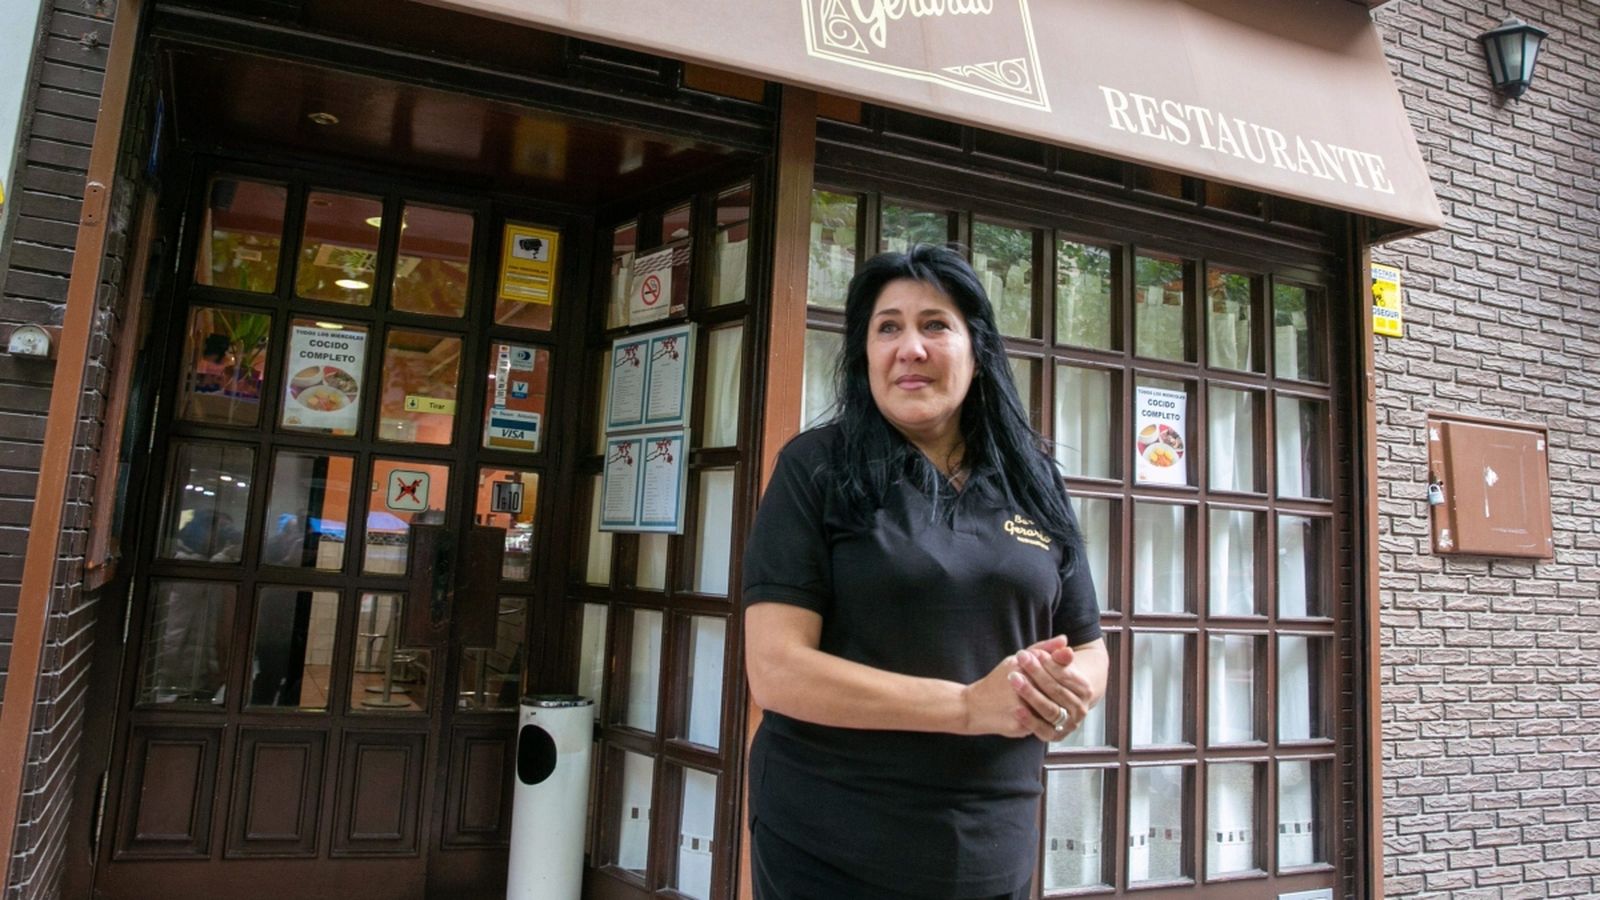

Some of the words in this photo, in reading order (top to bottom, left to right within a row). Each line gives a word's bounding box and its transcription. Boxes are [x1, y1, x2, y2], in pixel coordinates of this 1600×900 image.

[1099, 85, 1396, 195] RESTAURANTE
[309, 339, 349, 350] COCIDO
[299, 351, 355, 363] COMPLETO
[1147, 398, 1175, 409] COCIDO
[1141, 409, 1181, 421] COMPLETO
[502, 428, 525, 439] VISA
